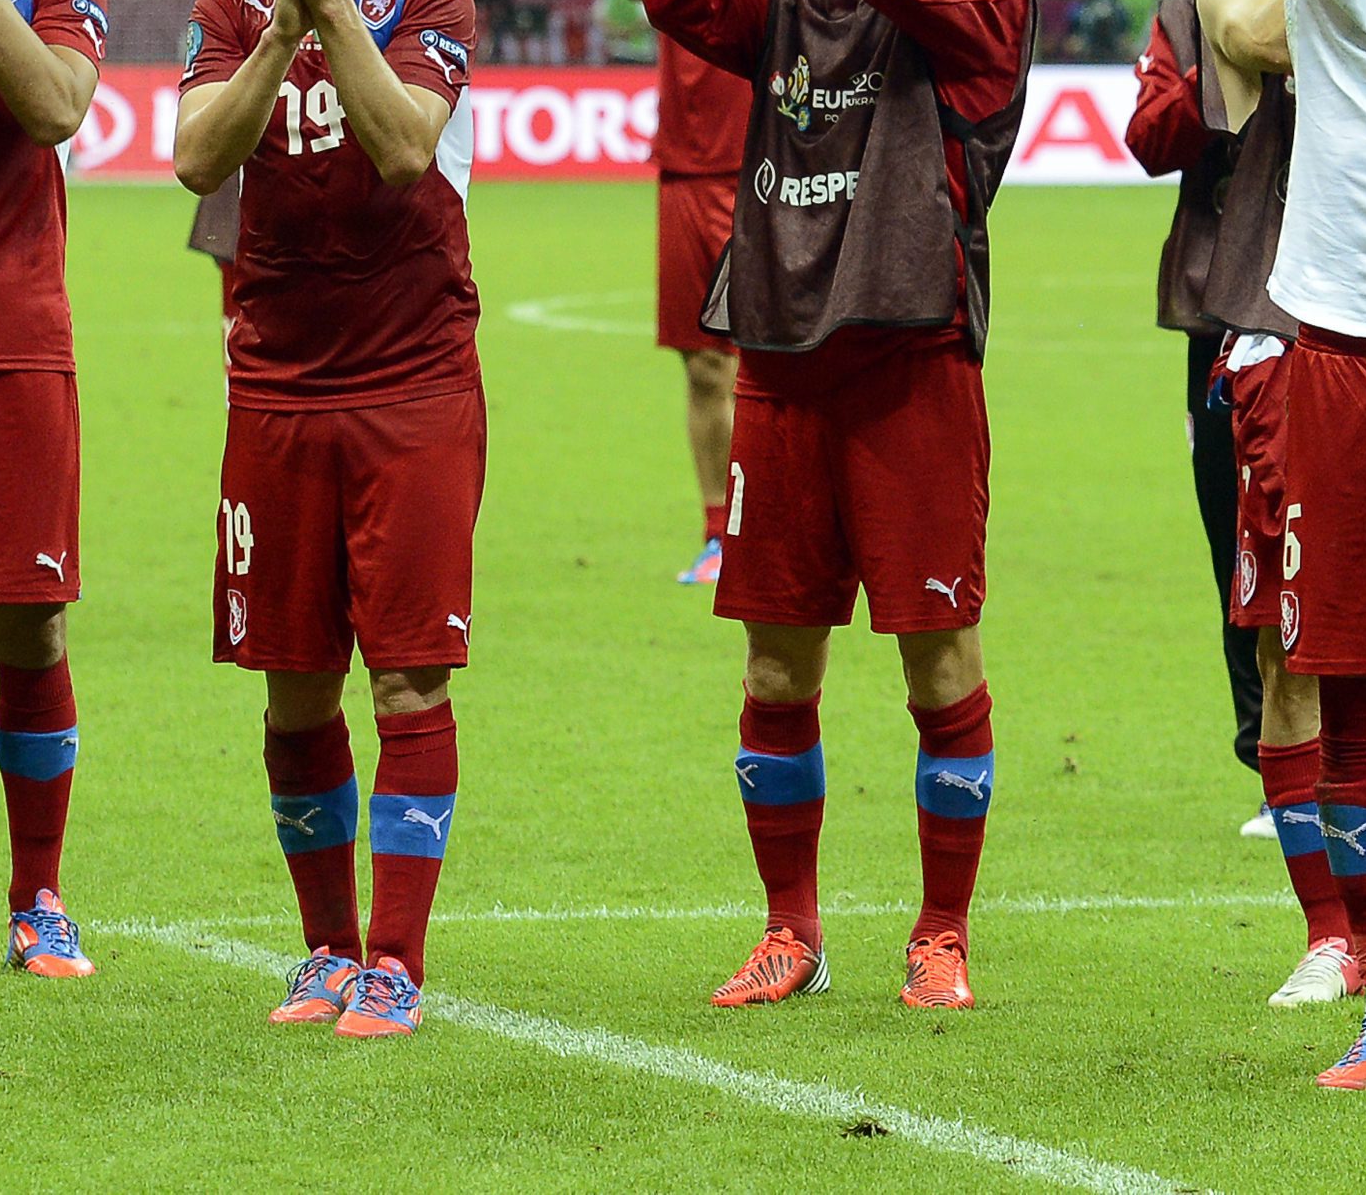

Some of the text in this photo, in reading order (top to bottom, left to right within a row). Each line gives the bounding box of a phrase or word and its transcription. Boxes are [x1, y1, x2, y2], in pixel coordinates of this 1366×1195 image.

[278, 79, 346, 155] 19
[222, 498, 255, 576] 19
[1283, 503, 1302, 581] 6
